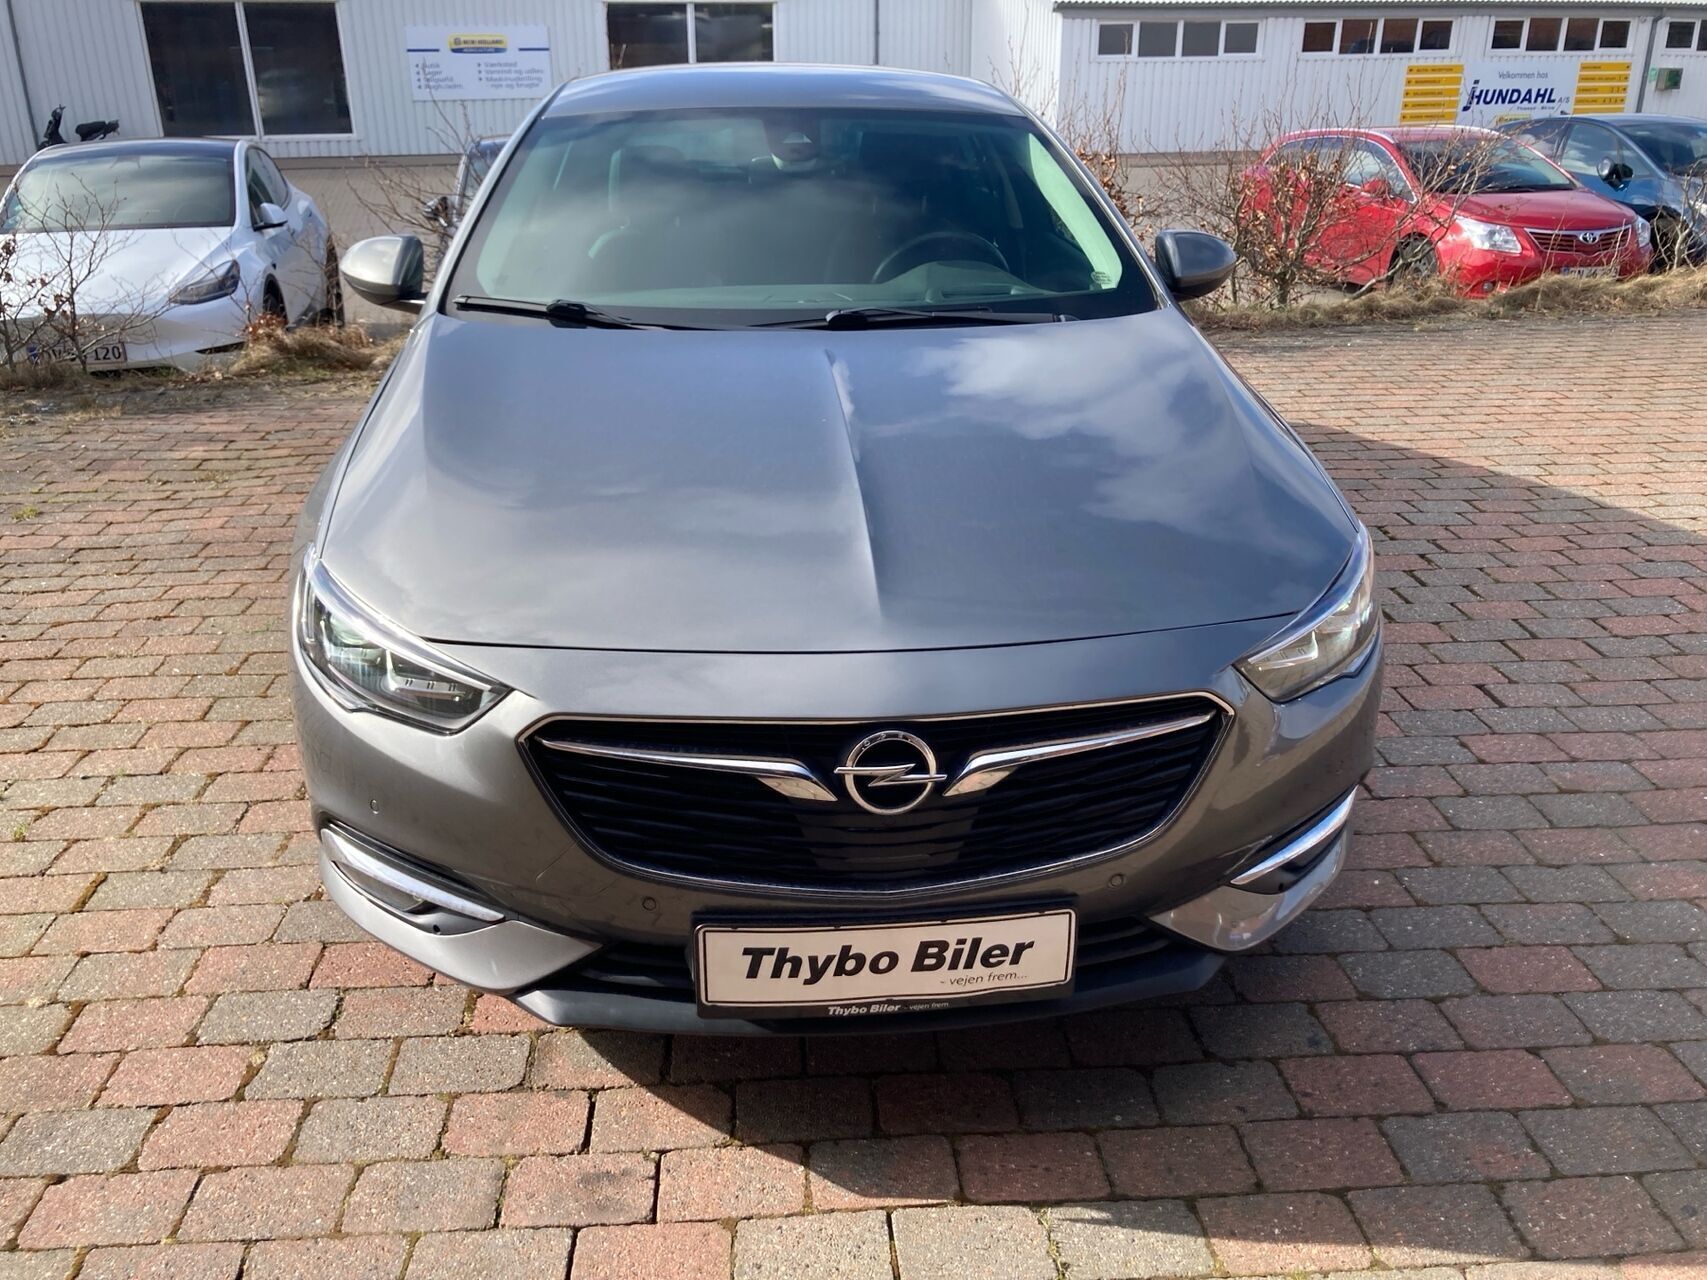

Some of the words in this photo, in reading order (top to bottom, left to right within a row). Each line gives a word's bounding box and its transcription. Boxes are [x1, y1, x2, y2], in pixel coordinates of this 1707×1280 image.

[1498, 71, 1535, 80] Velkommen
[741, 943, 899, 985] Thybo
[910, 937, 1035, 972] Biler
[949, 975, 984, 987] vejen
[828, 1006, 867, 1016] Thybo
[869, 1004, 901, 1013] Biler
